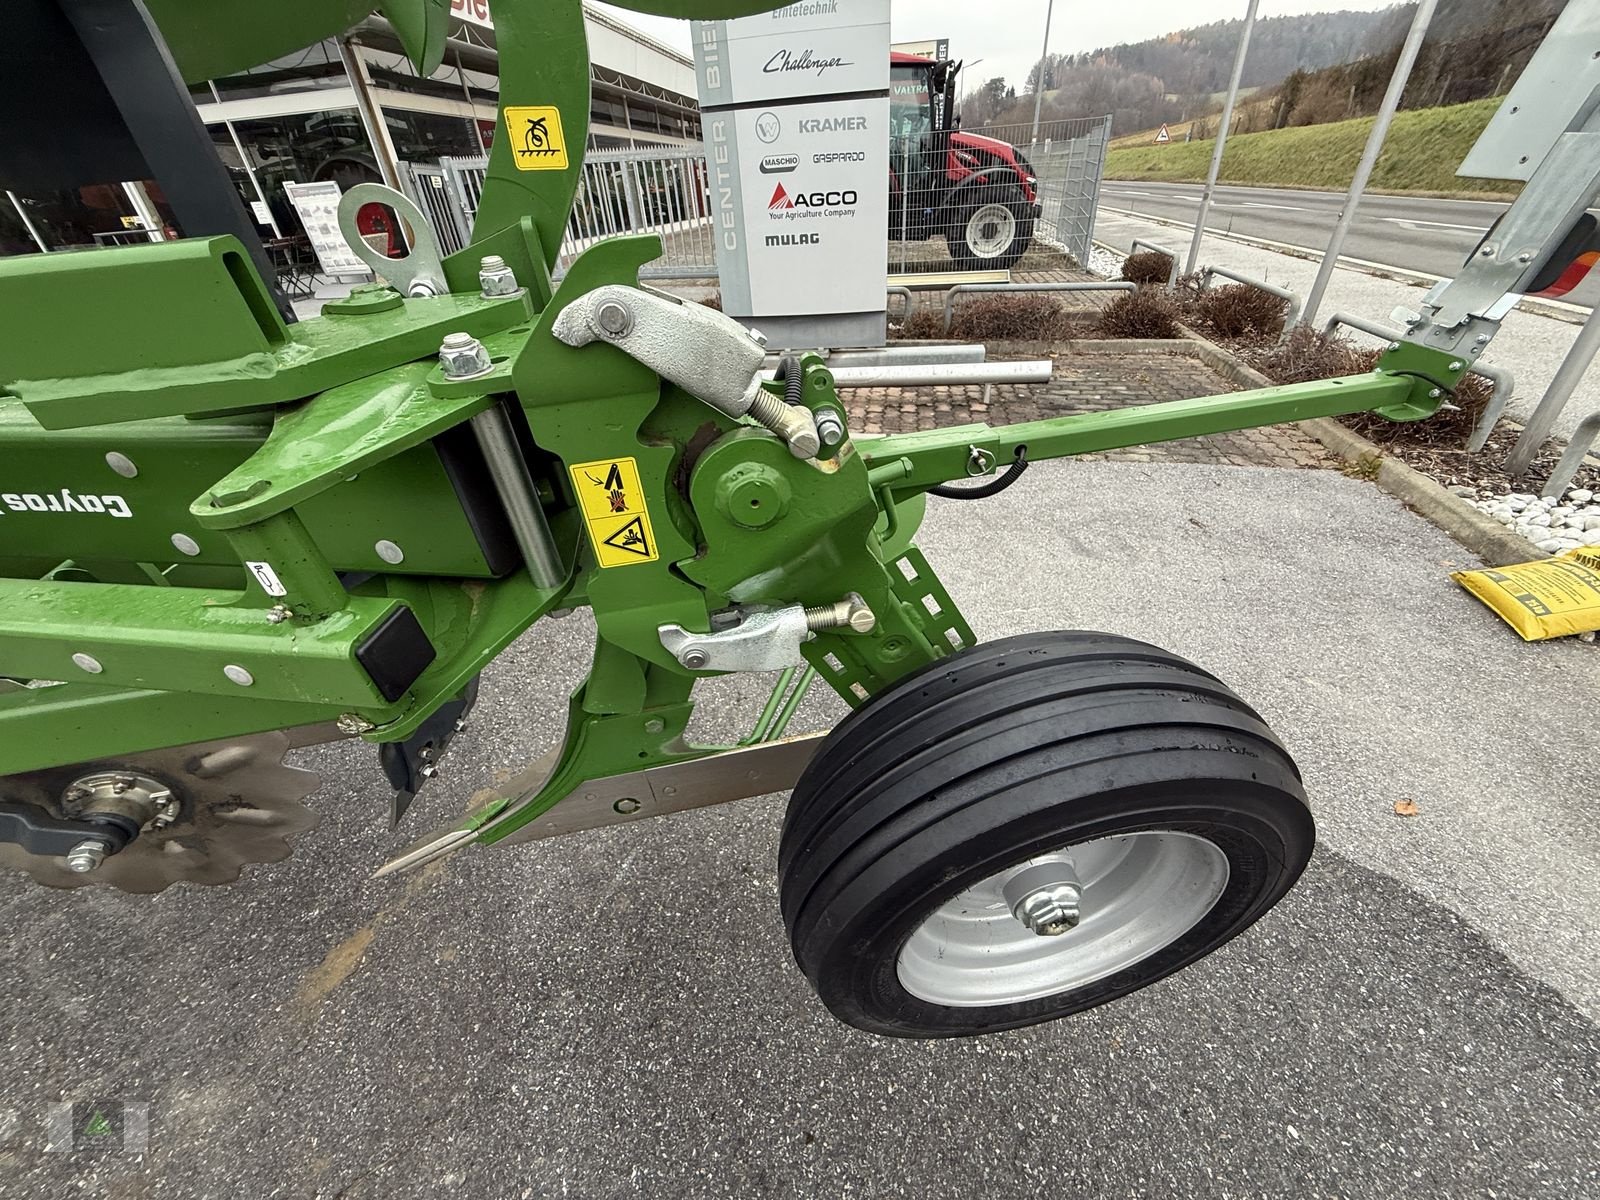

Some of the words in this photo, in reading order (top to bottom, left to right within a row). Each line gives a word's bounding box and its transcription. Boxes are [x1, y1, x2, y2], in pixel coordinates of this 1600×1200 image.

[772, 0, 838, 19] Erntetechnik
[701, 20, 720, 89] BIE
[762, 49, 855, 76] Challenger
[894, 84, 929, 95] VALTRA
[799, 116, 868, 133] KRAMER
[764, 157, 798, 166] MASCHIO
[813, 152, 865, 164] GASPARDO
[712, 120, 737, 250] CENTER
[794, 190, 858, 207] AGCO
[769, 212, 784, 220] Your
[785, 209, 822, 221] Agriculture
[824, 208, 856, 217] Company
[765, 233, 820, 246] MULAG
[1, 488, 133, 518] Cayros
